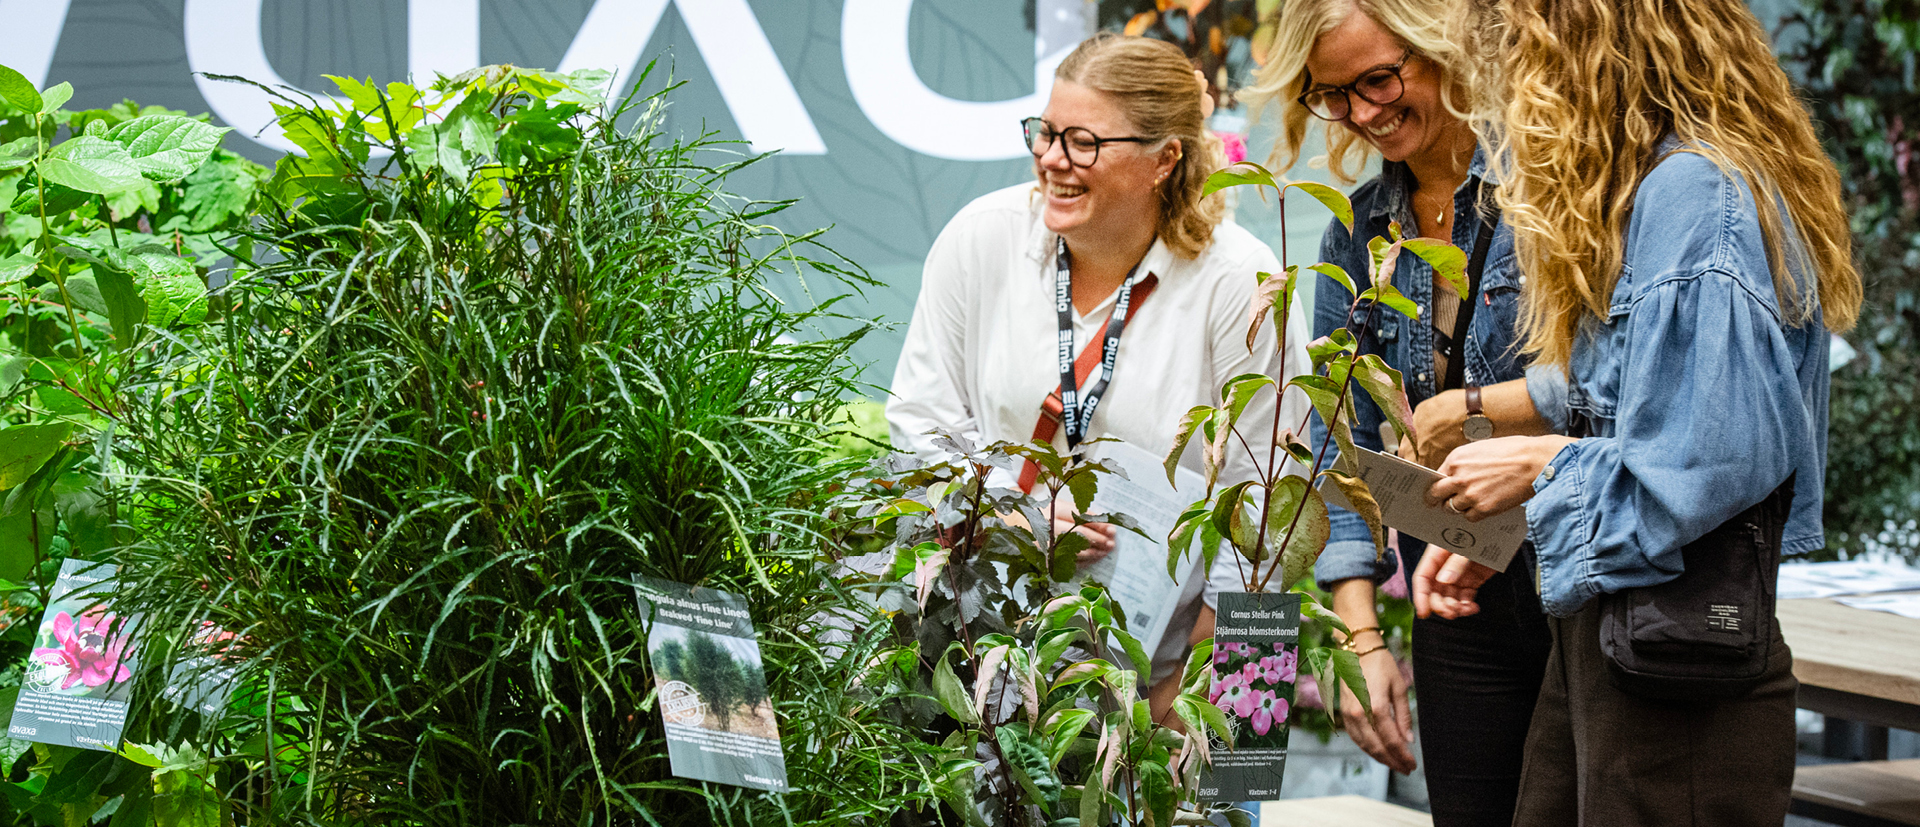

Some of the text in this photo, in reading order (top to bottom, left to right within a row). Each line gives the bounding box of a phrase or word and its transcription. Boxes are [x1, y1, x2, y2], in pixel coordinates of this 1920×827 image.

[1057, 269, 1071, 312] Elmia
[1112, 277, 1134, 320] Elmia
[1060, 329, 1073, 373] Elmia
[1102, 337, 1119, 382] Elmia
[1062, 390, 1079, 436] Elmia
[659, 608, 693, 622] Brakved
[676, 598, 701, 611] alnus
[701, 603, 721, 615] Fine
[1230, 610, 1285, 619] Cornus Stellar Pink
[1216, 626, 1299, 637] Stjärnrosa blomsterkornell
[11, 725, 37, 736] avaxa
[1199, 787, 1219, 796] avaxa
